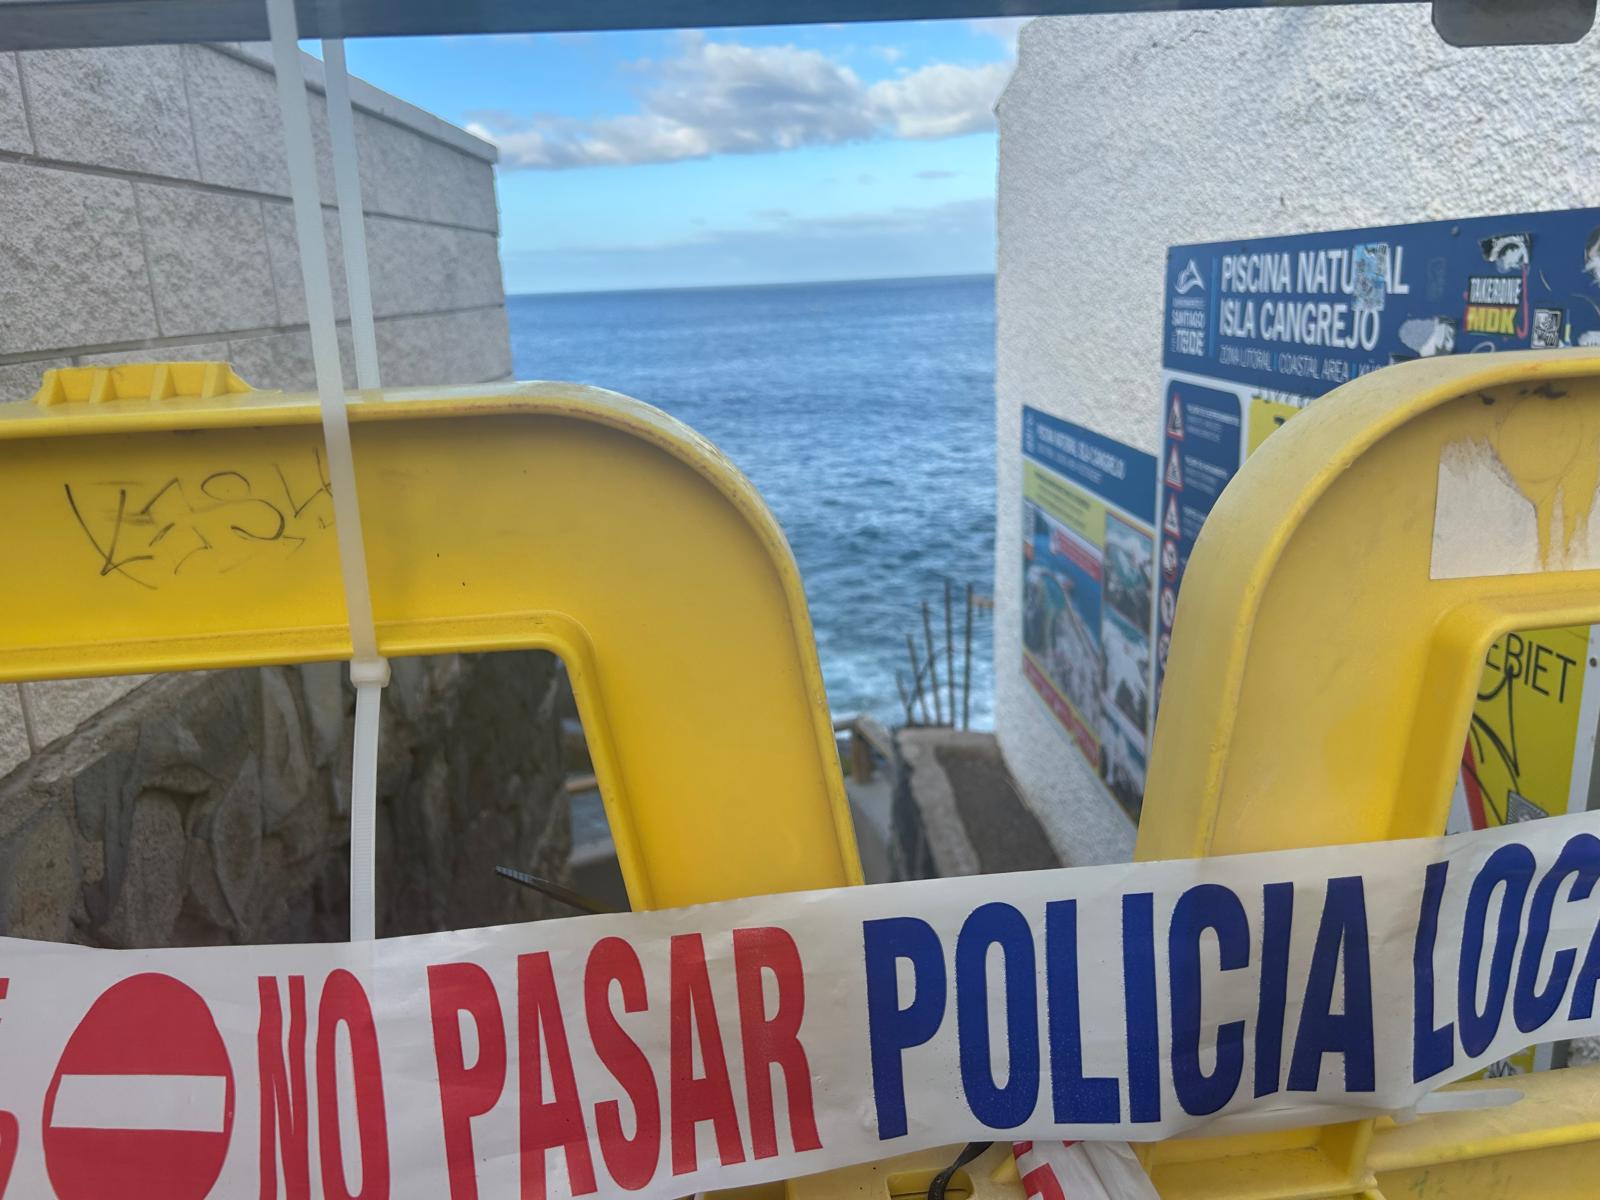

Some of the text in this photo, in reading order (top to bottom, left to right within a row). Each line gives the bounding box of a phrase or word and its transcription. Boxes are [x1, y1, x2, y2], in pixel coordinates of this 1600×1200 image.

[1221, 245, 1409, 294] PISCINA NATUAL
[1219, 298, 1380, 351] ISLA CANGREJO
[1466, 306, 1517, 335] MDK
[1278, 352, 1321, 380] COASTAL
[1320, 358, 1350, 383] AREA
[258, 968, 391, 1200] NO
[427, 926, 824, 1200] PASAR
[863, 876, 1376, 1140] POLICIA
